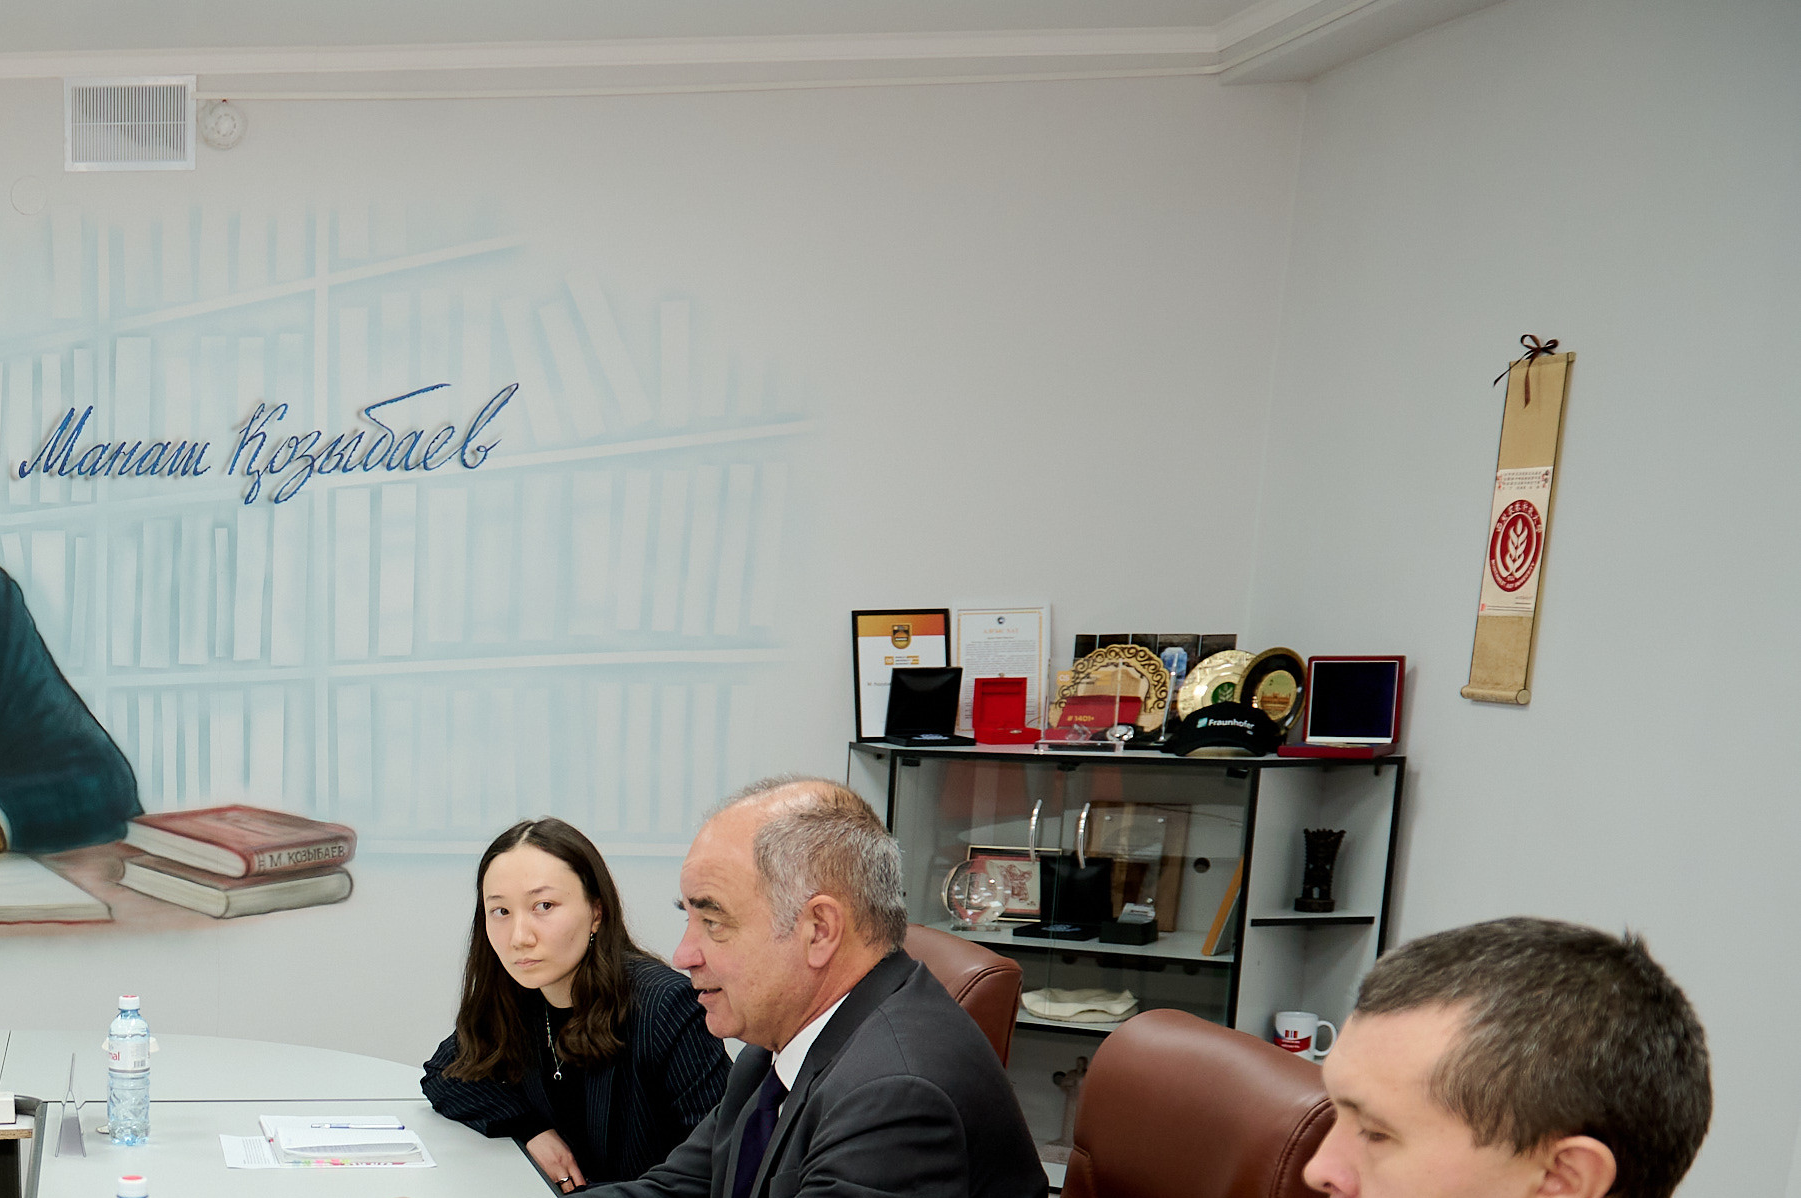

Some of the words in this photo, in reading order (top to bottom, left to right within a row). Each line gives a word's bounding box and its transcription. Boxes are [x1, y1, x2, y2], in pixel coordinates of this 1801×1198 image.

[19, 404, 211, 478] Манаш
[228, 382, 520, 504] Қозыбаев
[1208, 718, 1256, 730] Fraunhofer
[287, 845, 345, 864] КОЗЫБАЕВ
